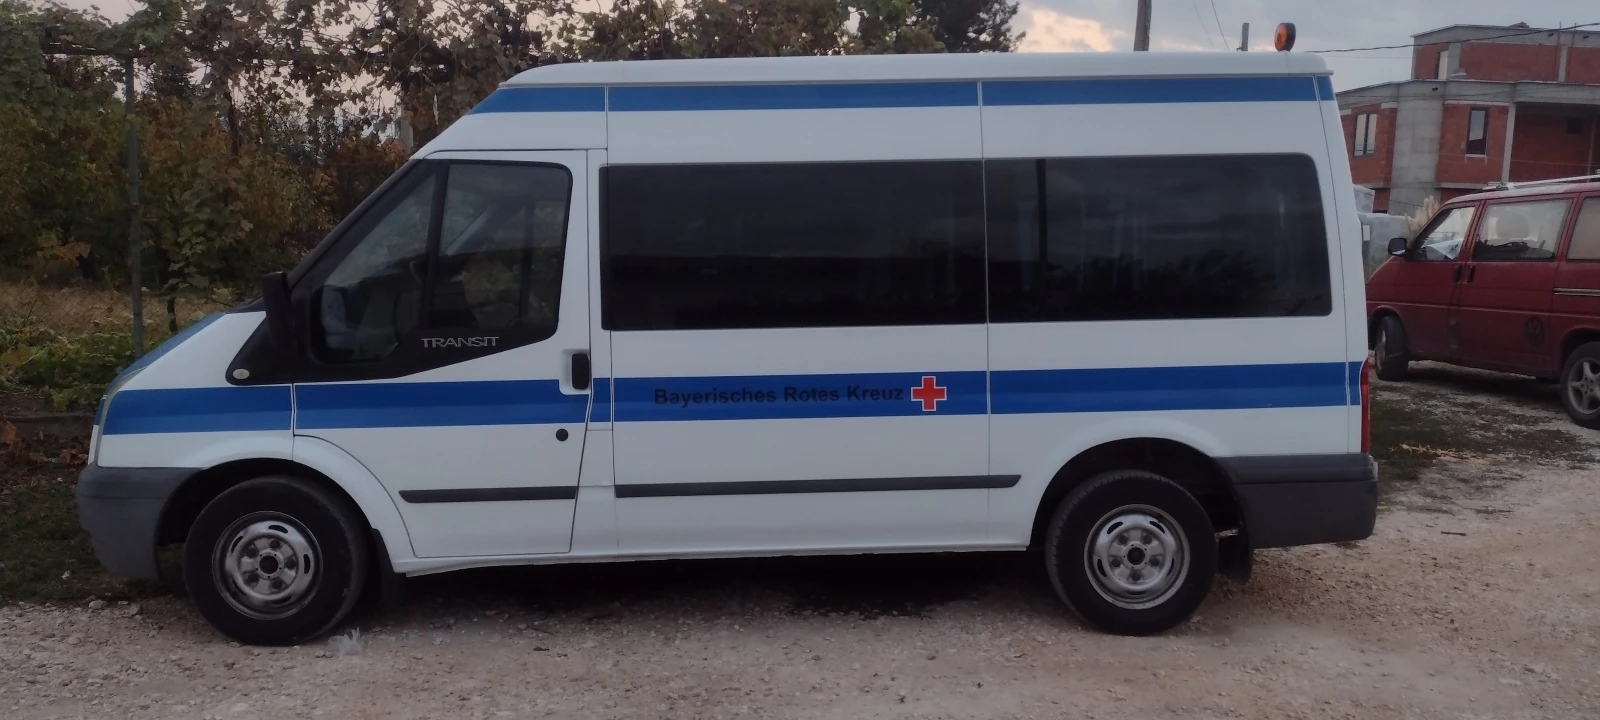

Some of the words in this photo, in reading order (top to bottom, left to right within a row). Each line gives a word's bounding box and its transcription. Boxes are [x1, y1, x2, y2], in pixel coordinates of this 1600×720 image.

[421, 336, 500, 348] TRANSIT
[653, 388, 777, 408] Bayerisches
[783, 386, 840, 402] Rotes
[846, 385, 904, 401] Kreuz
